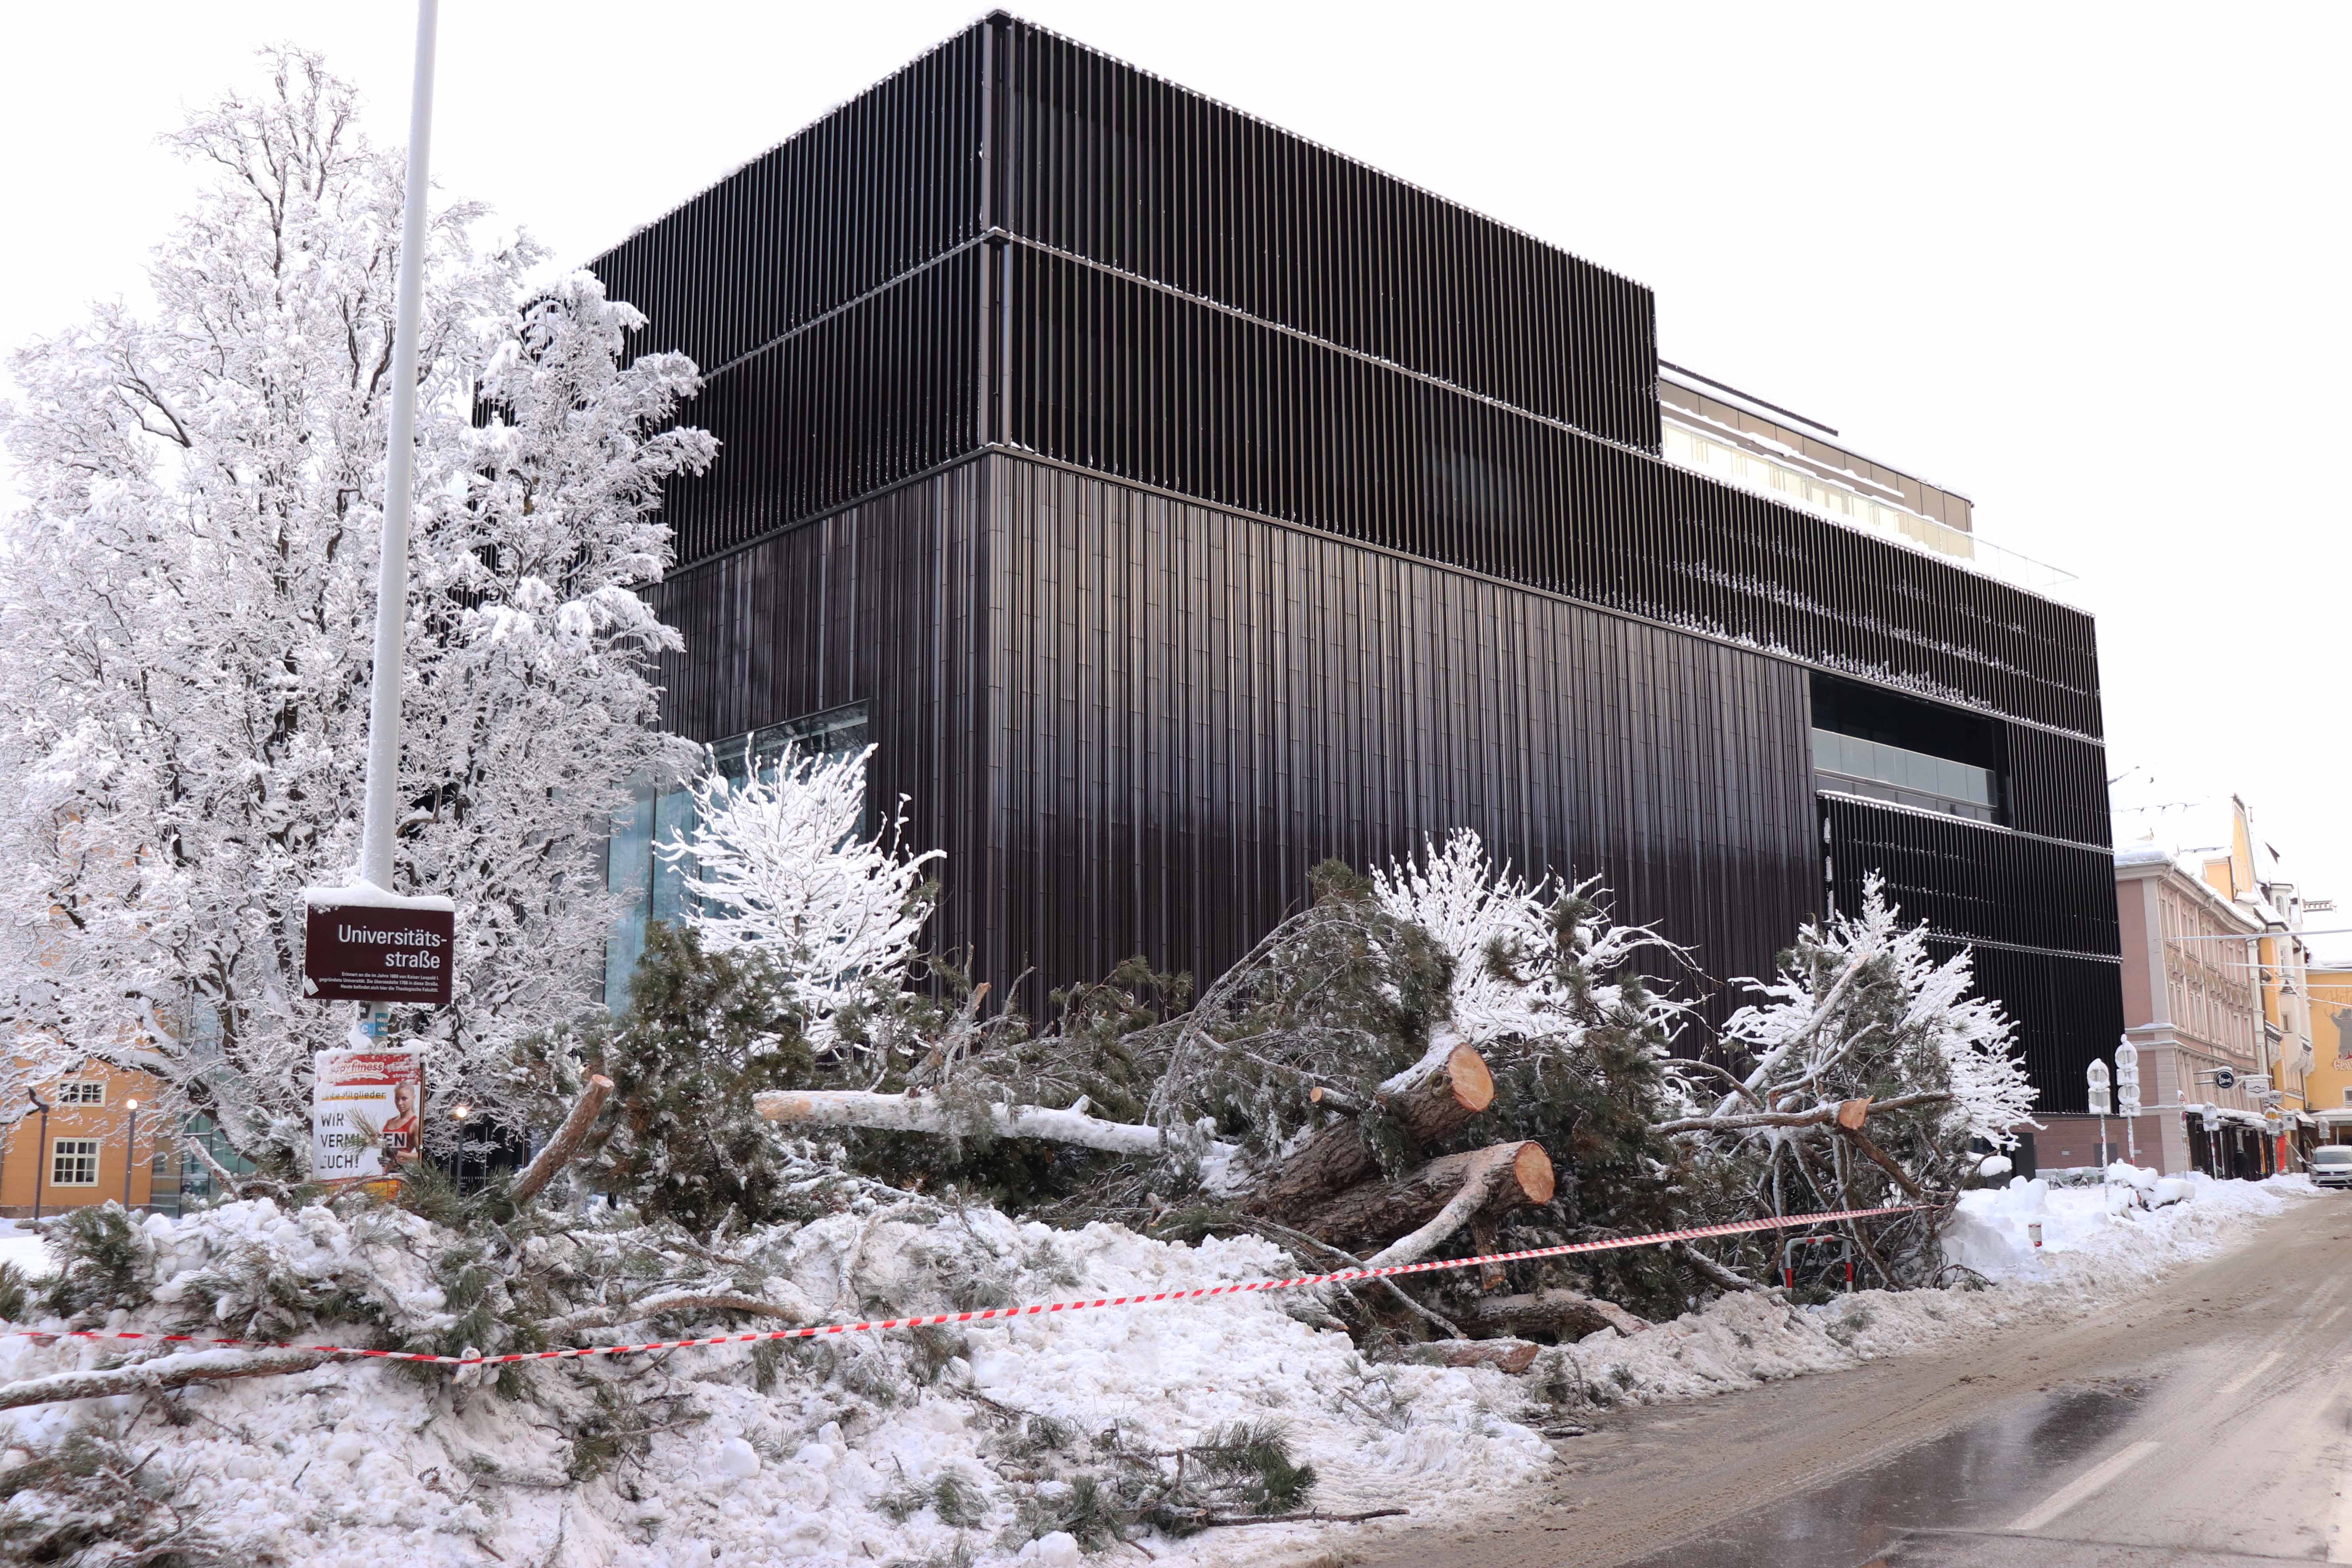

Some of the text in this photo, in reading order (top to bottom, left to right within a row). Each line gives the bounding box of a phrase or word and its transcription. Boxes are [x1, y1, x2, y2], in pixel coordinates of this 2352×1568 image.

[338, 924, 447, 947] Universitäts-
[386, 950, 440, 969] straße
[321, 1113, 344, 1127] WIR
[321, 1133, 405, 1147] VERMEN
